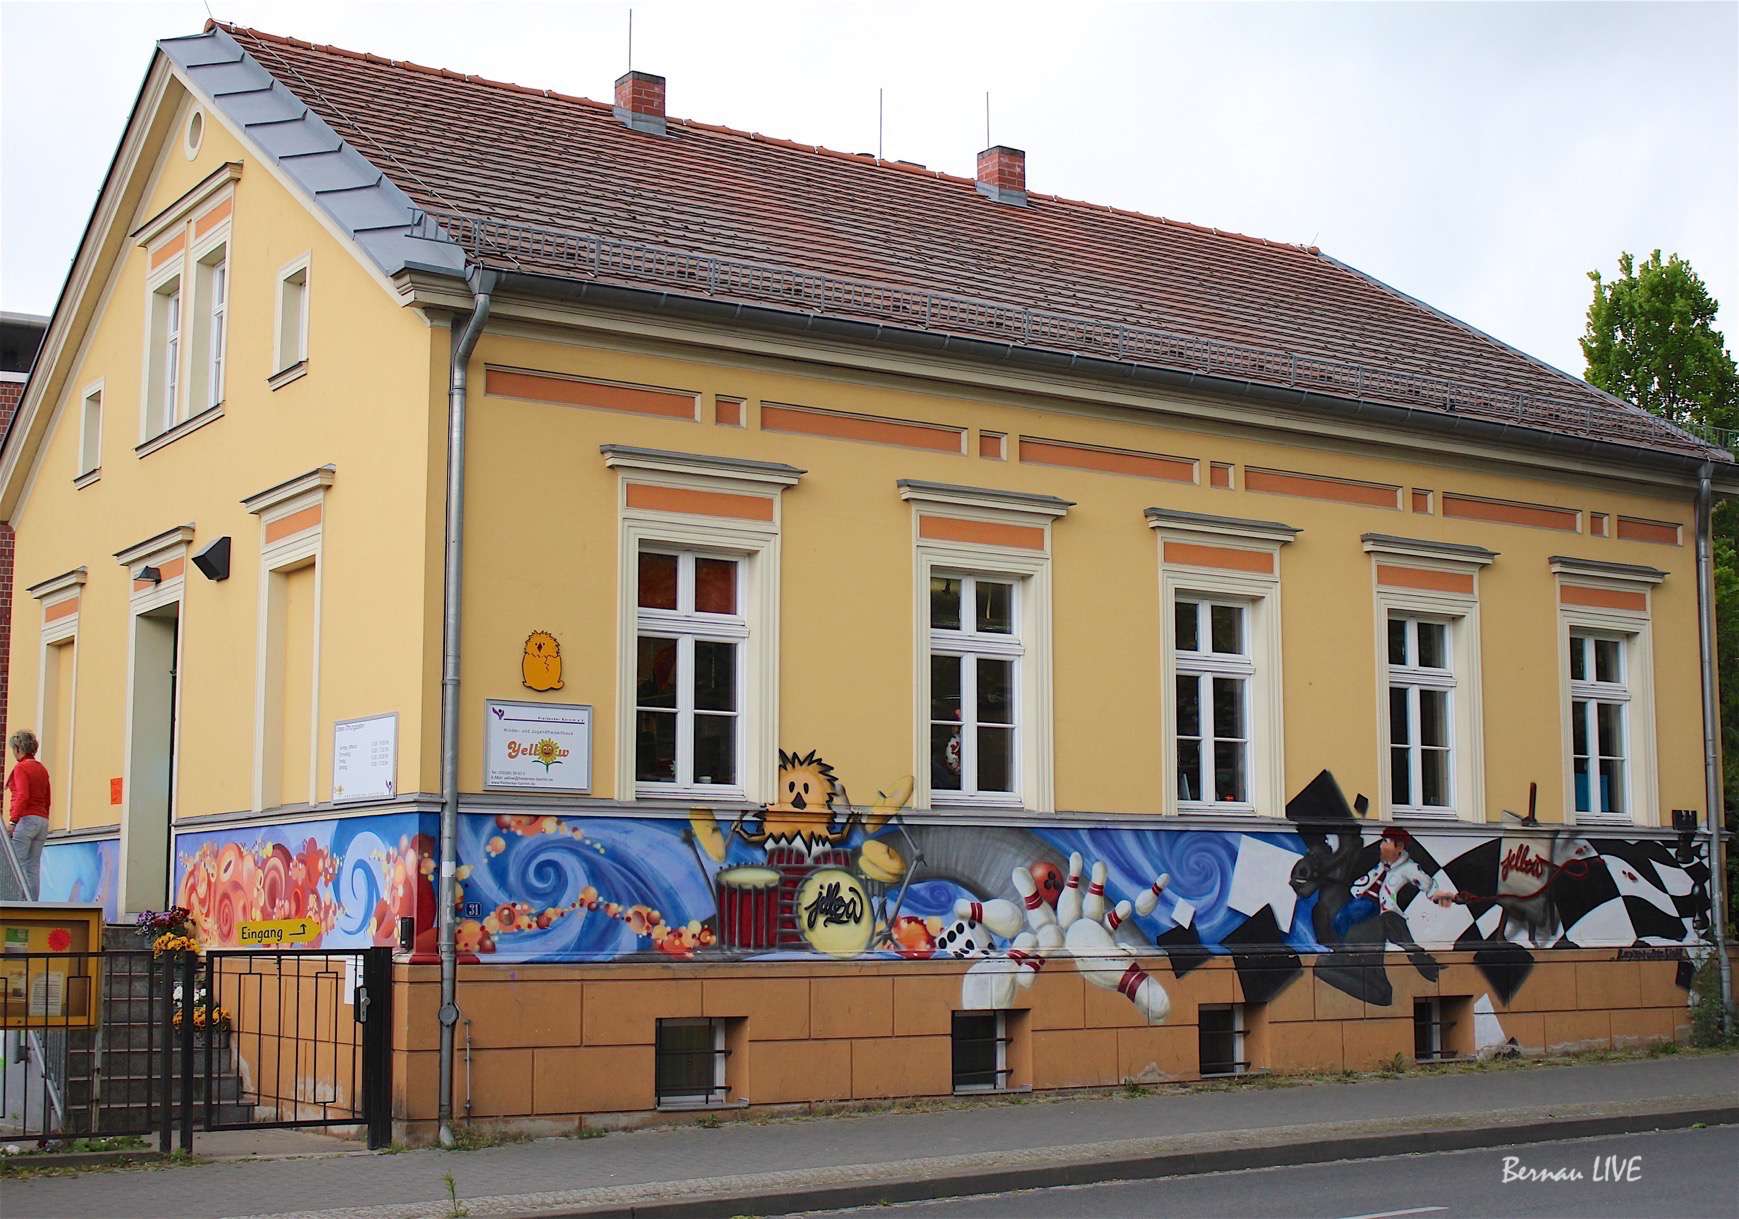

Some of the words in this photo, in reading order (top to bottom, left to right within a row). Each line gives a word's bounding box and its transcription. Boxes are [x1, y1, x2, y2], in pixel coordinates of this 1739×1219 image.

[507, 740, 569, 759] Yellow
[468, 903, 479, 916] 31
[241, 926, 283, 943] Eingang
